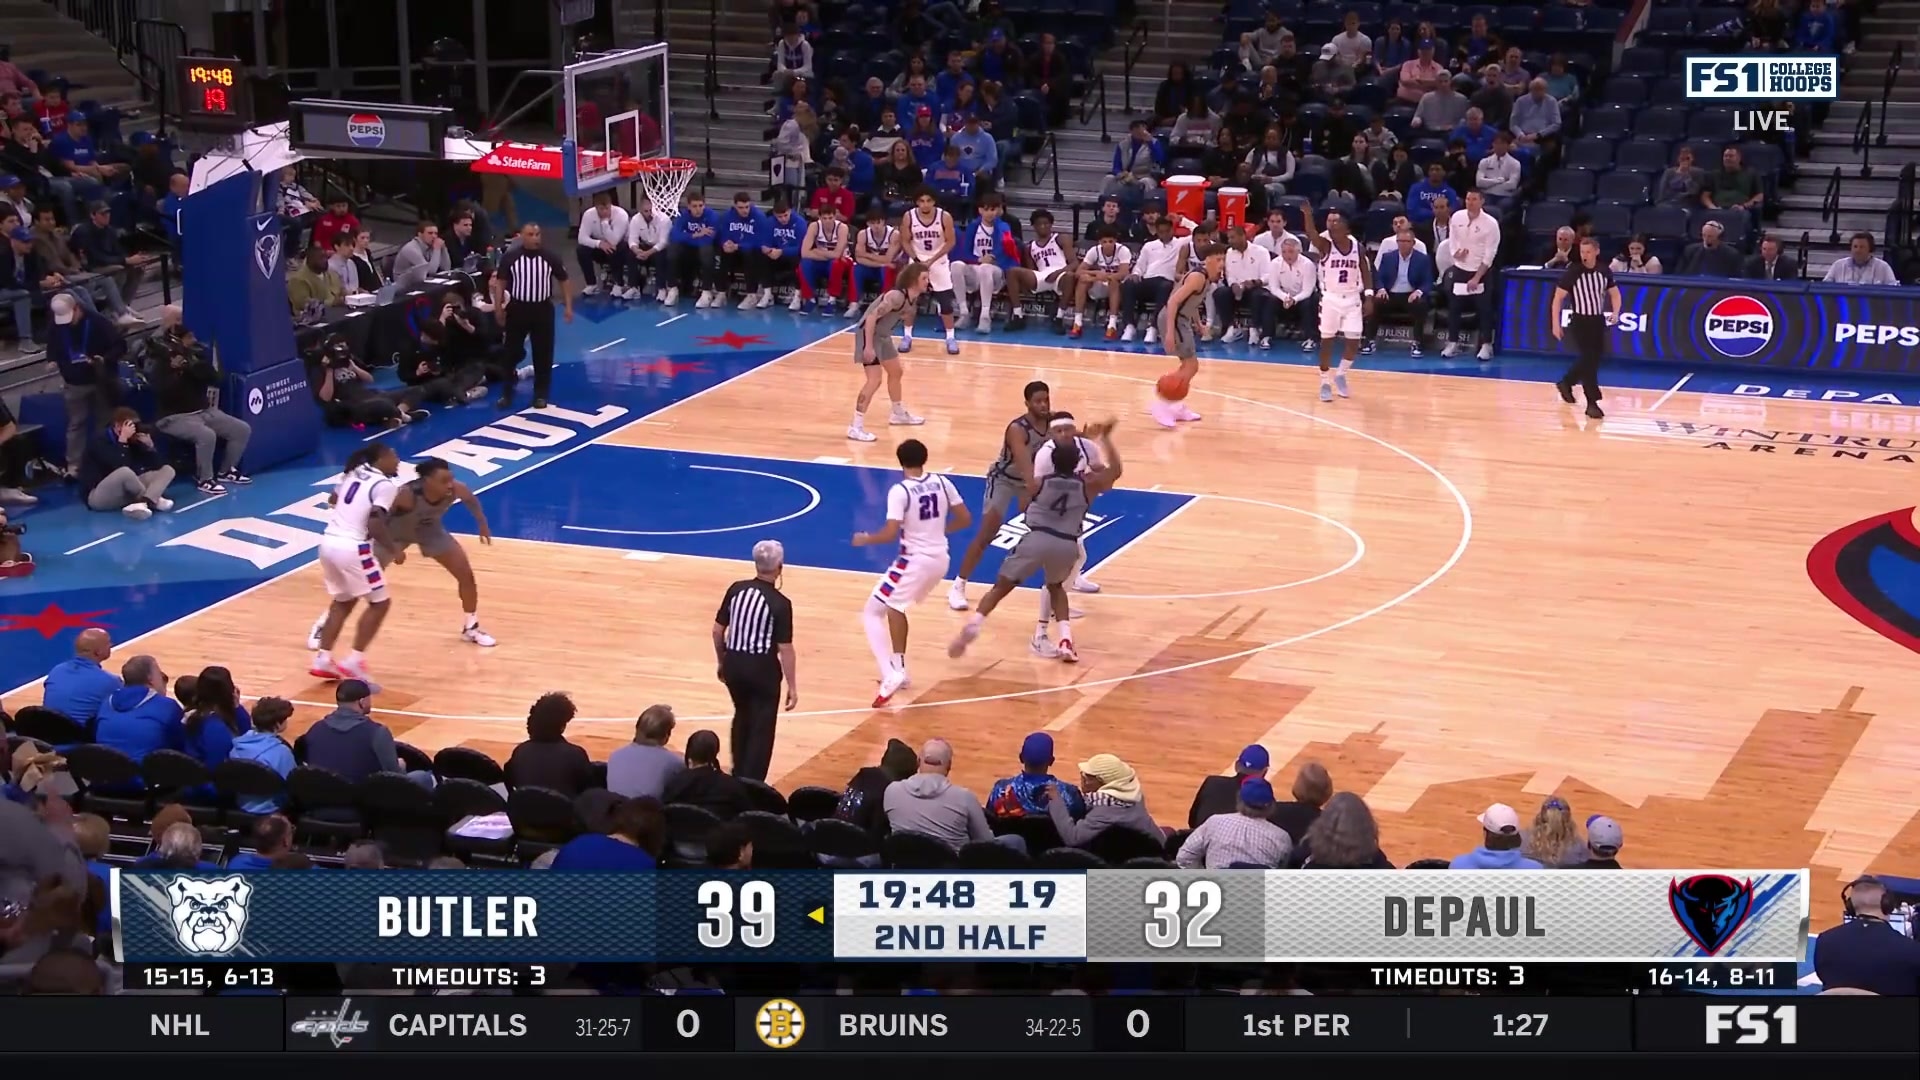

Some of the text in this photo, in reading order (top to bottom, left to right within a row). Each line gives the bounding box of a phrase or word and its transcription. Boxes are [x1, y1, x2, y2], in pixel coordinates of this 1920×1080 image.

[190, 66, 233, 86] 19:48
[204, 88, 226, 111] 19
[349, 124, 384, 136] PEPSI
[924, 240, 932, 251] 5
[1043, 257, 1050, 267] 1
[1338, 269, 1348, 283] 2
[1561, 309, 1647, 332] PSI
[1708, 319, 1769, 334] PEPSI
[1702, 441, 1915, 463] ARENA
[344, 481, 361, 504] 0
[919, 493, 939, 520] 21
[1050, 492, 1070, 516] 4
